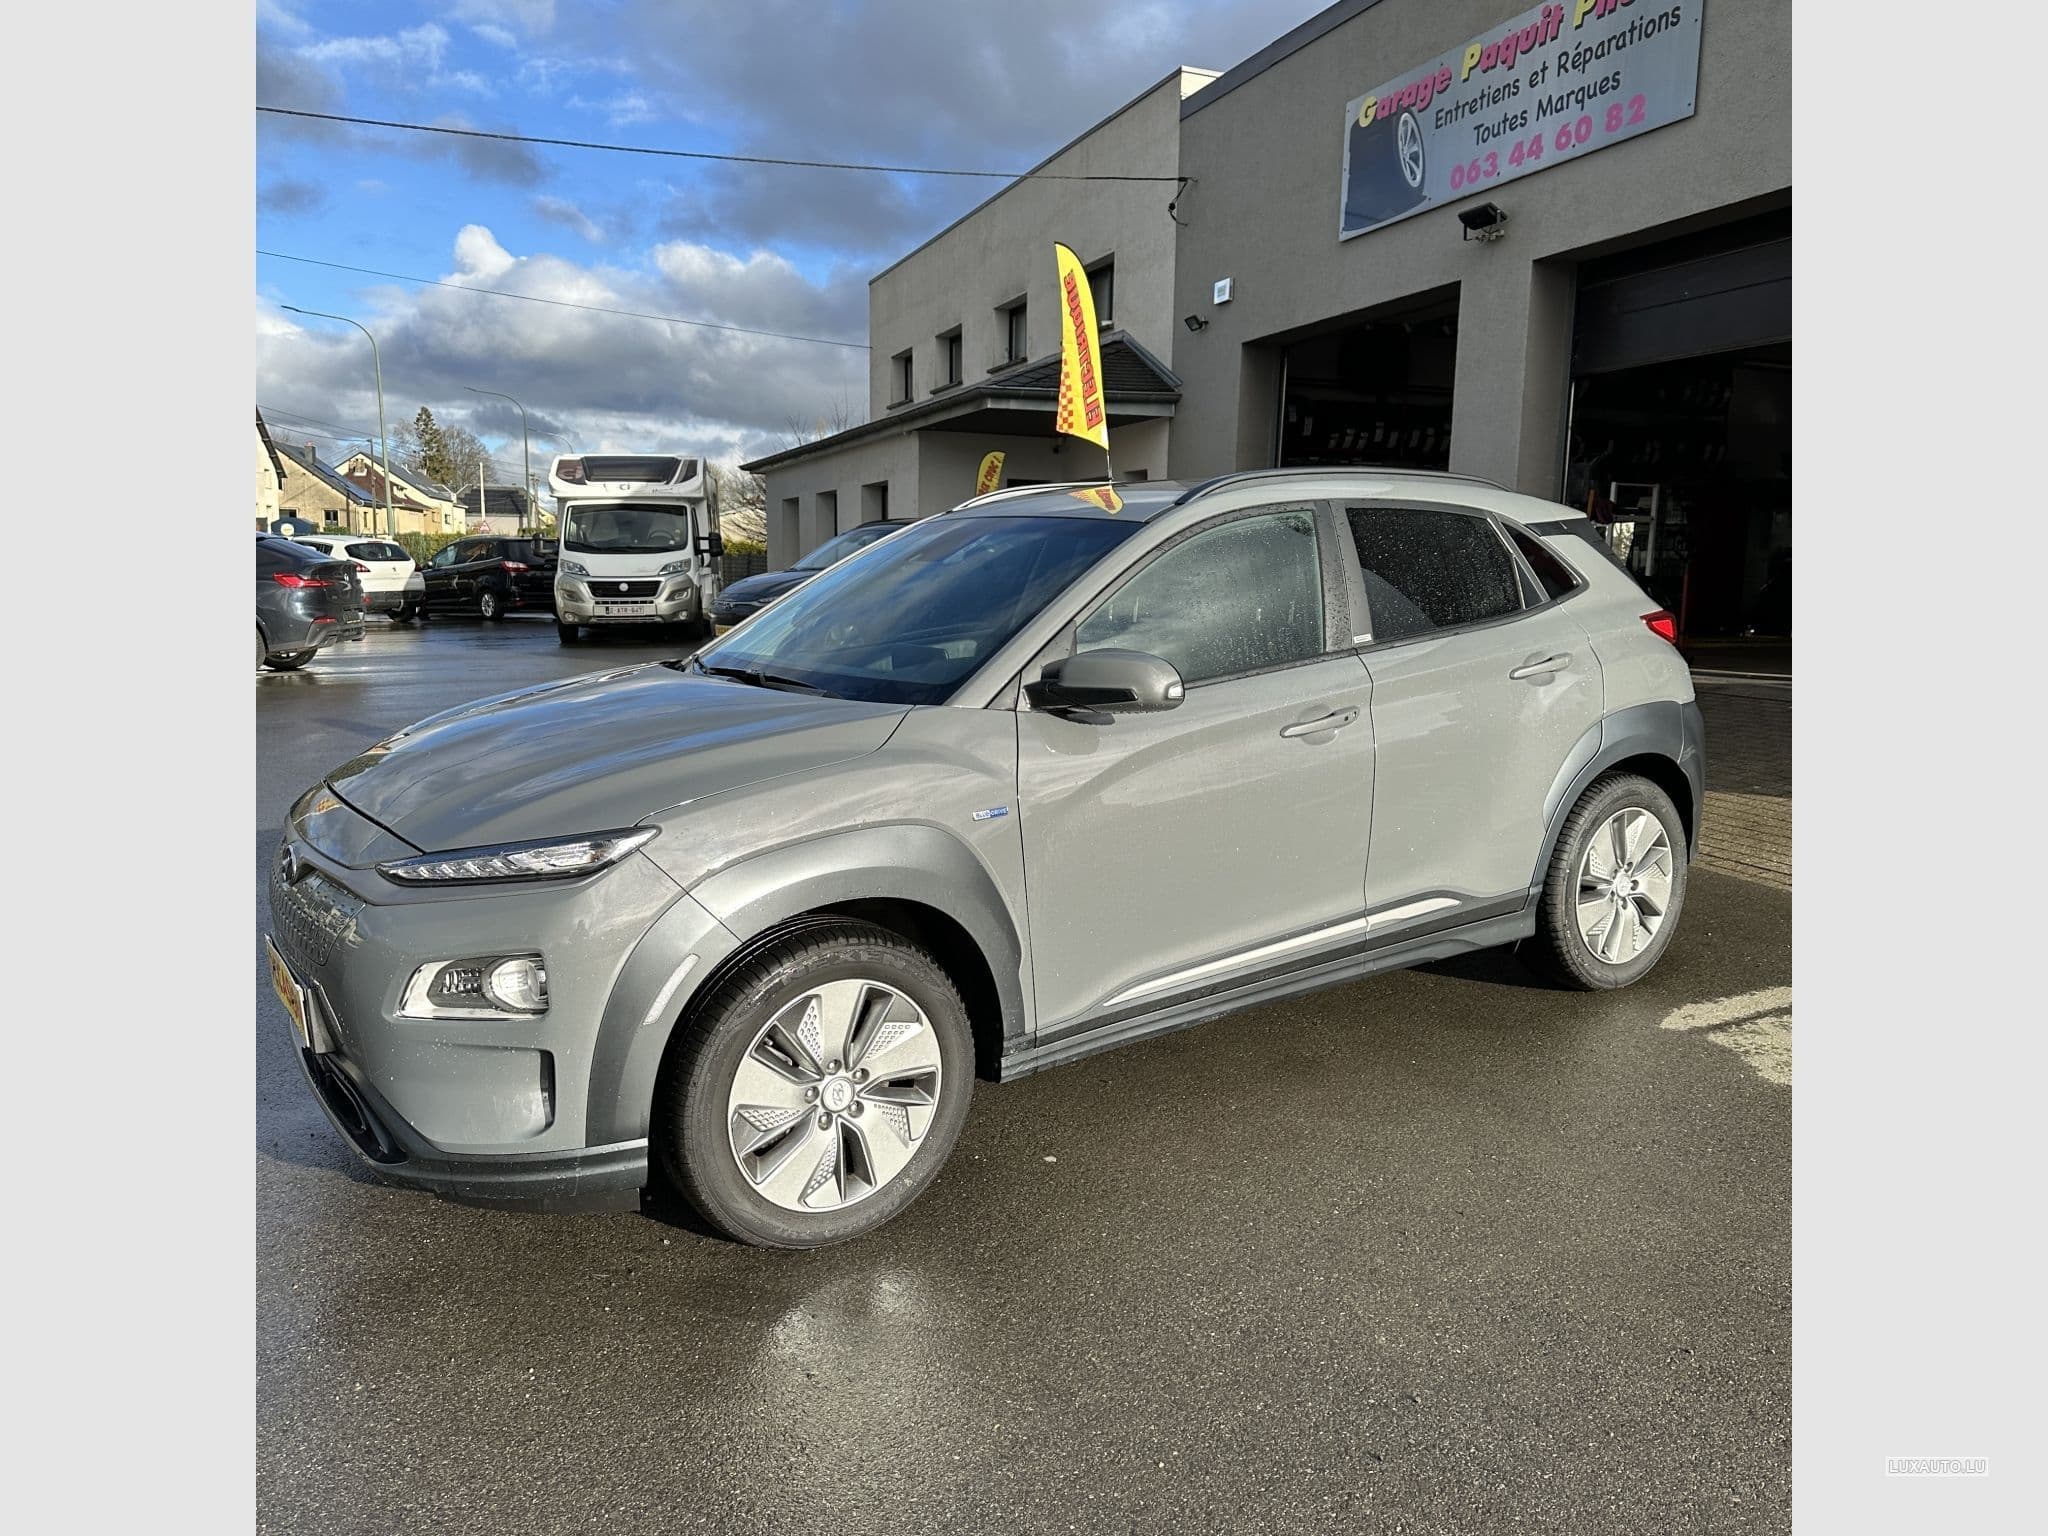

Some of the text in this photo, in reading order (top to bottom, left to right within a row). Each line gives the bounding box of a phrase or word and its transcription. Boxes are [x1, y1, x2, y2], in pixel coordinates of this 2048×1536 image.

[1358, 65, 1452, 127] Garage
[1460, 3, 1565, 83] Paquit
[1434, 6, 1681, 130] Entretiens et Réparations
[1473, 70, 1621, 146] Toutes Marques
[1449, 93, 1648, 190] 063 44 60 82
